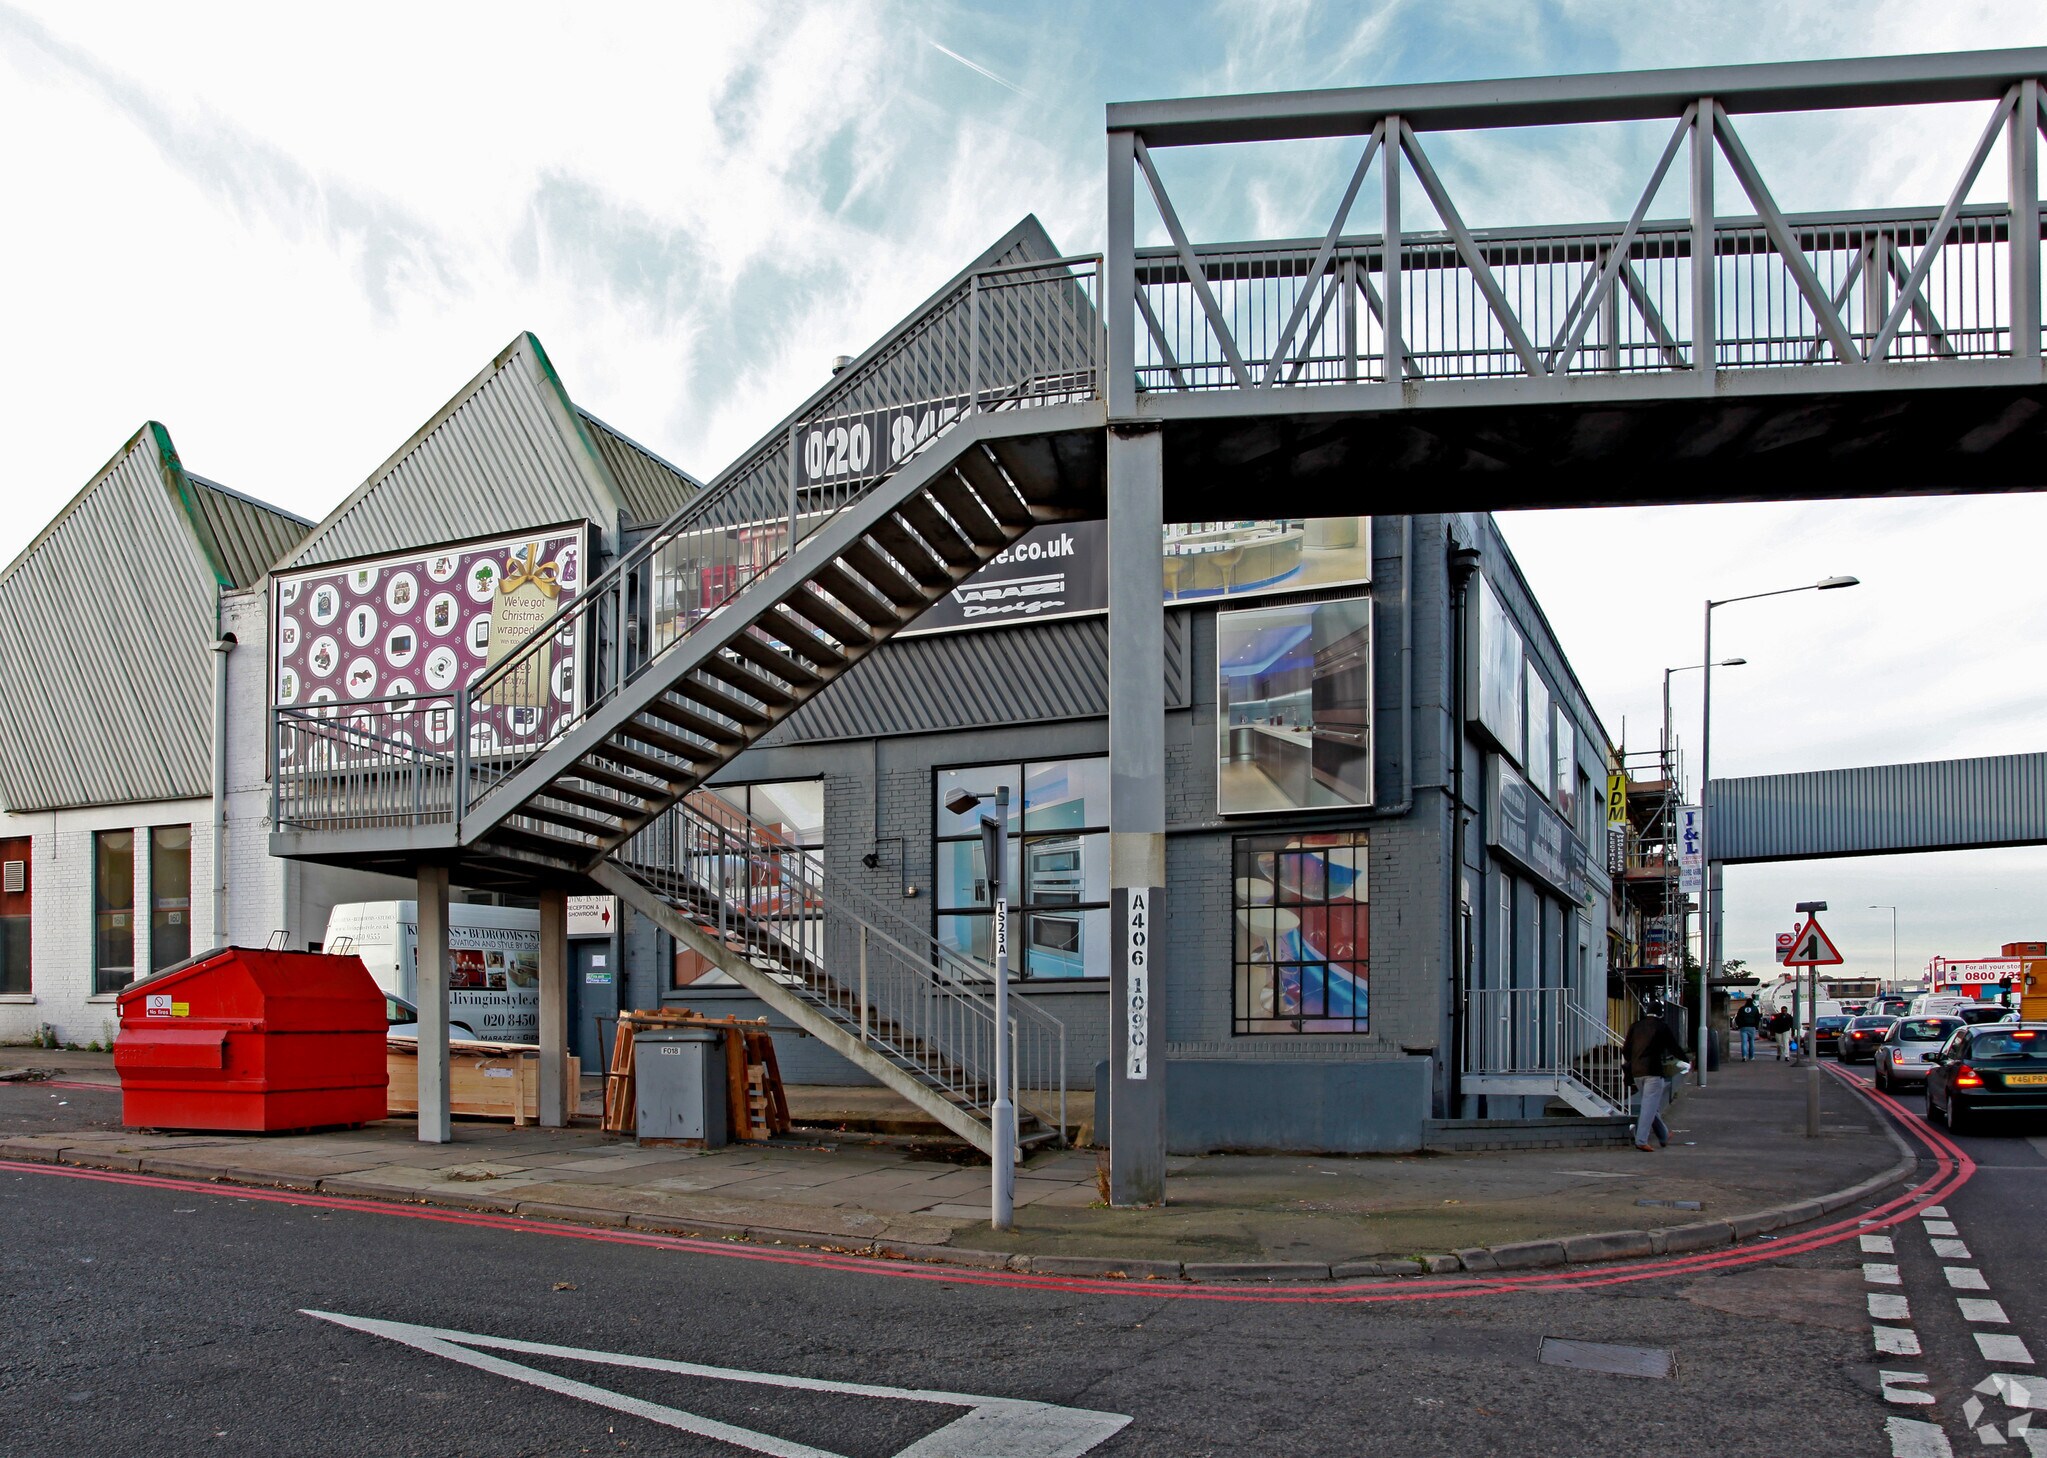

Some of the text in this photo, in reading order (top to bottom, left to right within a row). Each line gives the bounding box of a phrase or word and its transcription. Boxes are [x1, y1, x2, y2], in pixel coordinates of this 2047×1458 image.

[805, 423, 870, 479] 020
[504, 596, 545, 609] We've got
[963, 601, 1065, 617] Design
[501, 610, 544, 621] Christmas
[497, 625, 535, 636] wrapped
[1608, 777, 1624, 820] JDM
[1616, 835, 1624, 872] WHOLESALE
[469, 928, 524, 940] BEDROOMS
[998, 902, 1006, 954] TS23A
[1132, 894, 1146, 966] A406
[449, 938, 480, 947] OVATION
[482, 939, 496, 948] AND
[498, 940, 514, 949] STYLE
[516, 941, 522, 949] BY
[1965, 972, 1995, 981] 0800
[484, 1013, 536, 1027] 020 8450
